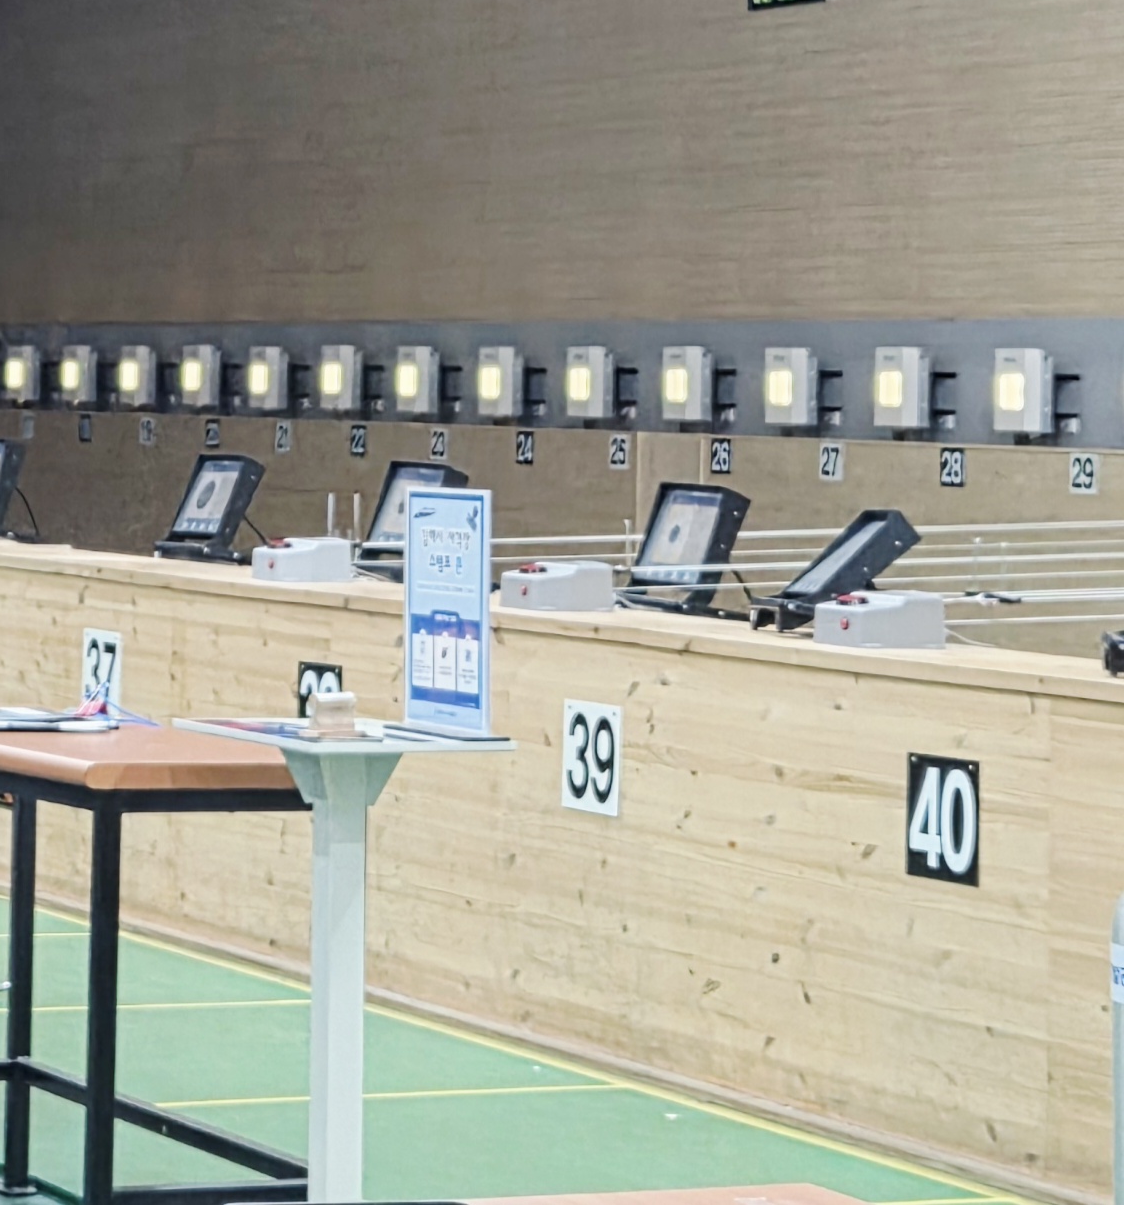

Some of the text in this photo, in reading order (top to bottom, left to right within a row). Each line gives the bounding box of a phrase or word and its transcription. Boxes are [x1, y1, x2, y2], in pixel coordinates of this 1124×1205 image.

[351, 427, 366, 452] 22
[431, 430, 445, 457] 23
[517, 434, 533, 462] 24
[610, 437, 626, 465] 25
[711, 441, 730, 472] 26
[820, 446, 839, 477] 27
[940, 450, 963, 484] 28
[1071, 456, 1094, 489] 29
[86, 637, 117, 702] 37
[566, 711, 615, 804] 39
[909, 766, 976, 875] 40
